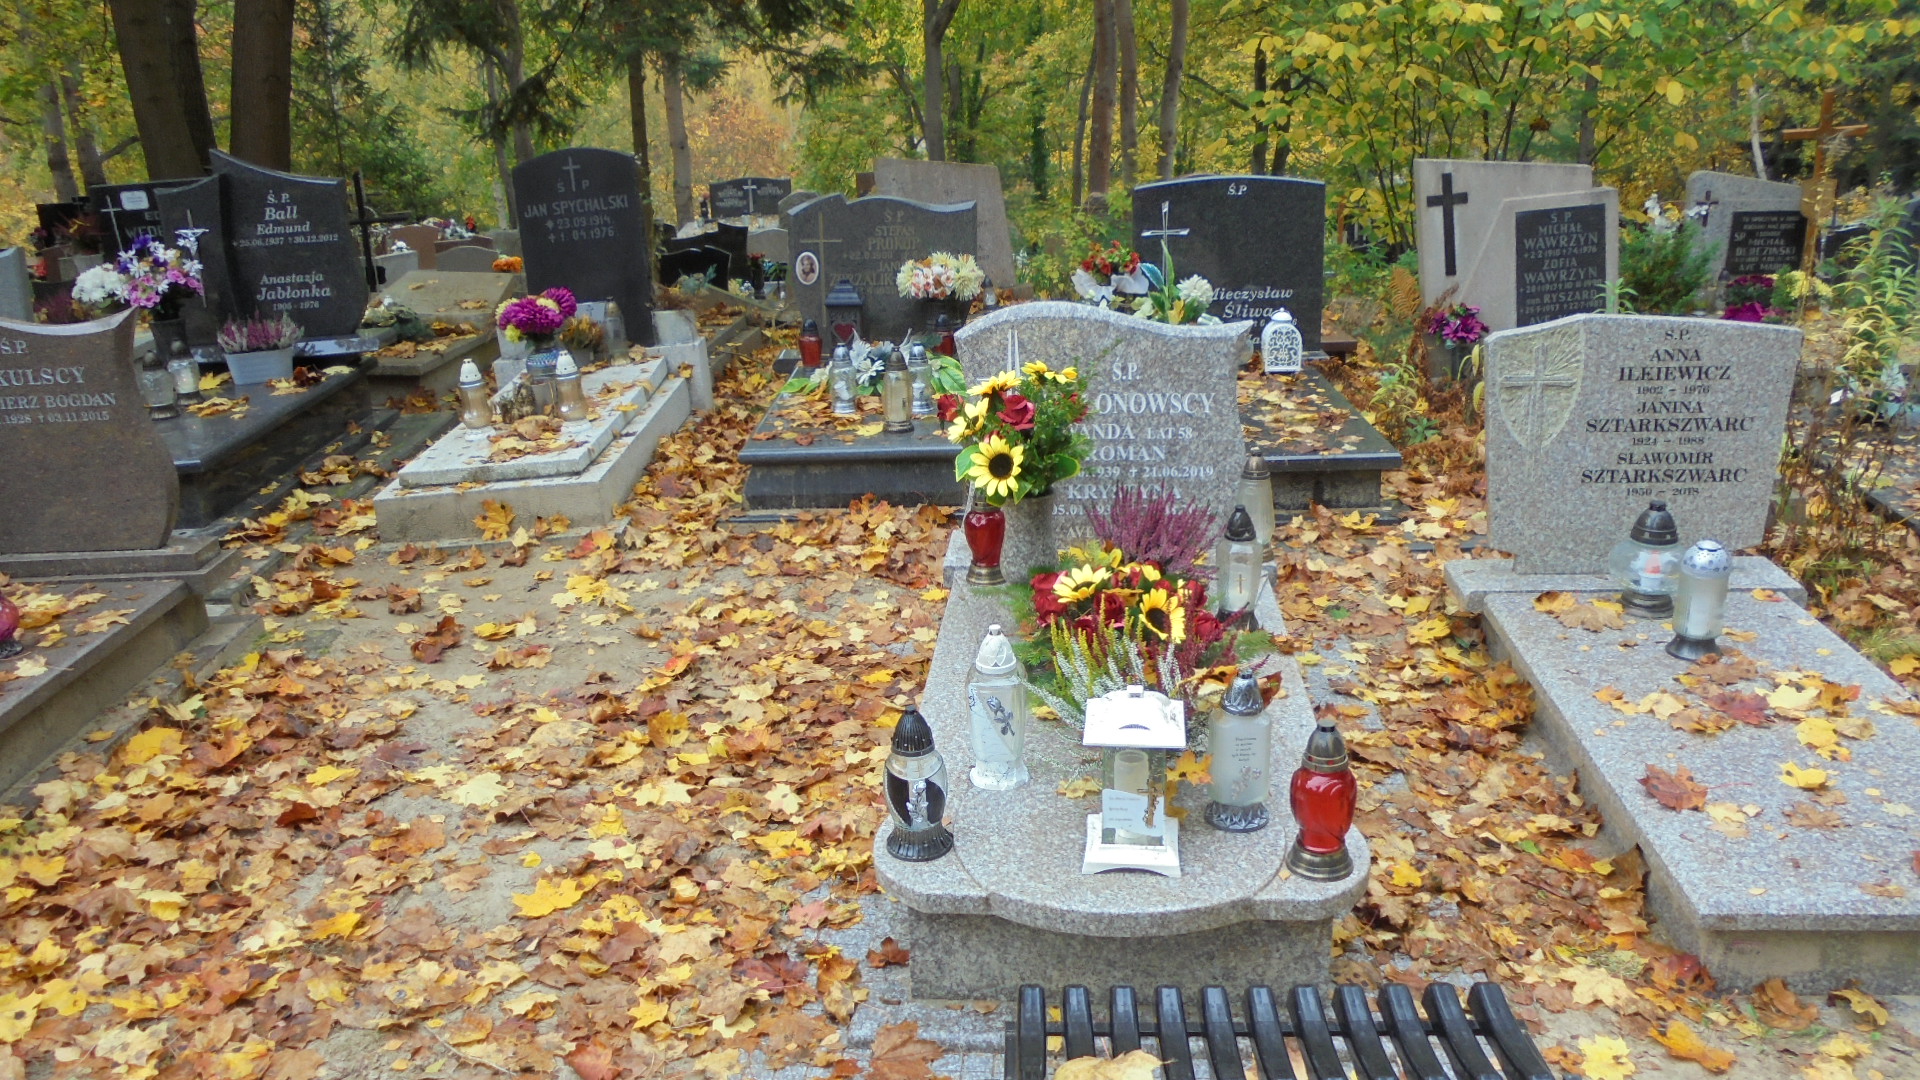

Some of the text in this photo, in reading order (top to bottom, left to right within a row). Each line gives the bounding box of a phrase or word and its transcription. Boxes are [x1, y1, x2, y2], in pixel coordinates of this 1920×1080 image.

[264, 206, 298, 220] Ball
[524, 195, 629, 218] JAN SPYCHALSKI
[256, 221, 311, 235] Edmund
[1538, 221, 1583, 236] MICHAŁ
[1523, 231, 1598, 250] WAWRZYN
[1542, 257, 1578, 270] ZOFIA
[260, 271, 324, 284] Anastazja
[1523, 266, 1598, 284] WAWRZYN
[257, 285, 333, 301] Jabłonka
[1543, 290, 1598, 304] RYSZARD
[1222, 301, 1274, 319] Śliwa
[1650, 349, 1702, 362] ANNA
[1618, 365, 1732, 382] ILKIEWICZ
[1637, 386, 1664, 395] 1902
[1683, 385, 1711, 395] 1976
[43, 393, 116, 408] BOGDAN
[1636, 401, 1704, 414] JANINA
[1585, 416, 1757, 433] SZTARKSZWARC
[1146, 428, 1175, 440] LAT
[1178, 427, 1194, 440] 58
[1617, 452, 1713, 465] SŁAWOMIR
[1142, 465, 1215, 479] 21.06.2019
[1580, 468, 1748, 484] SZTARKSZWARC
[1671, 487, 1700, 496] 2018
